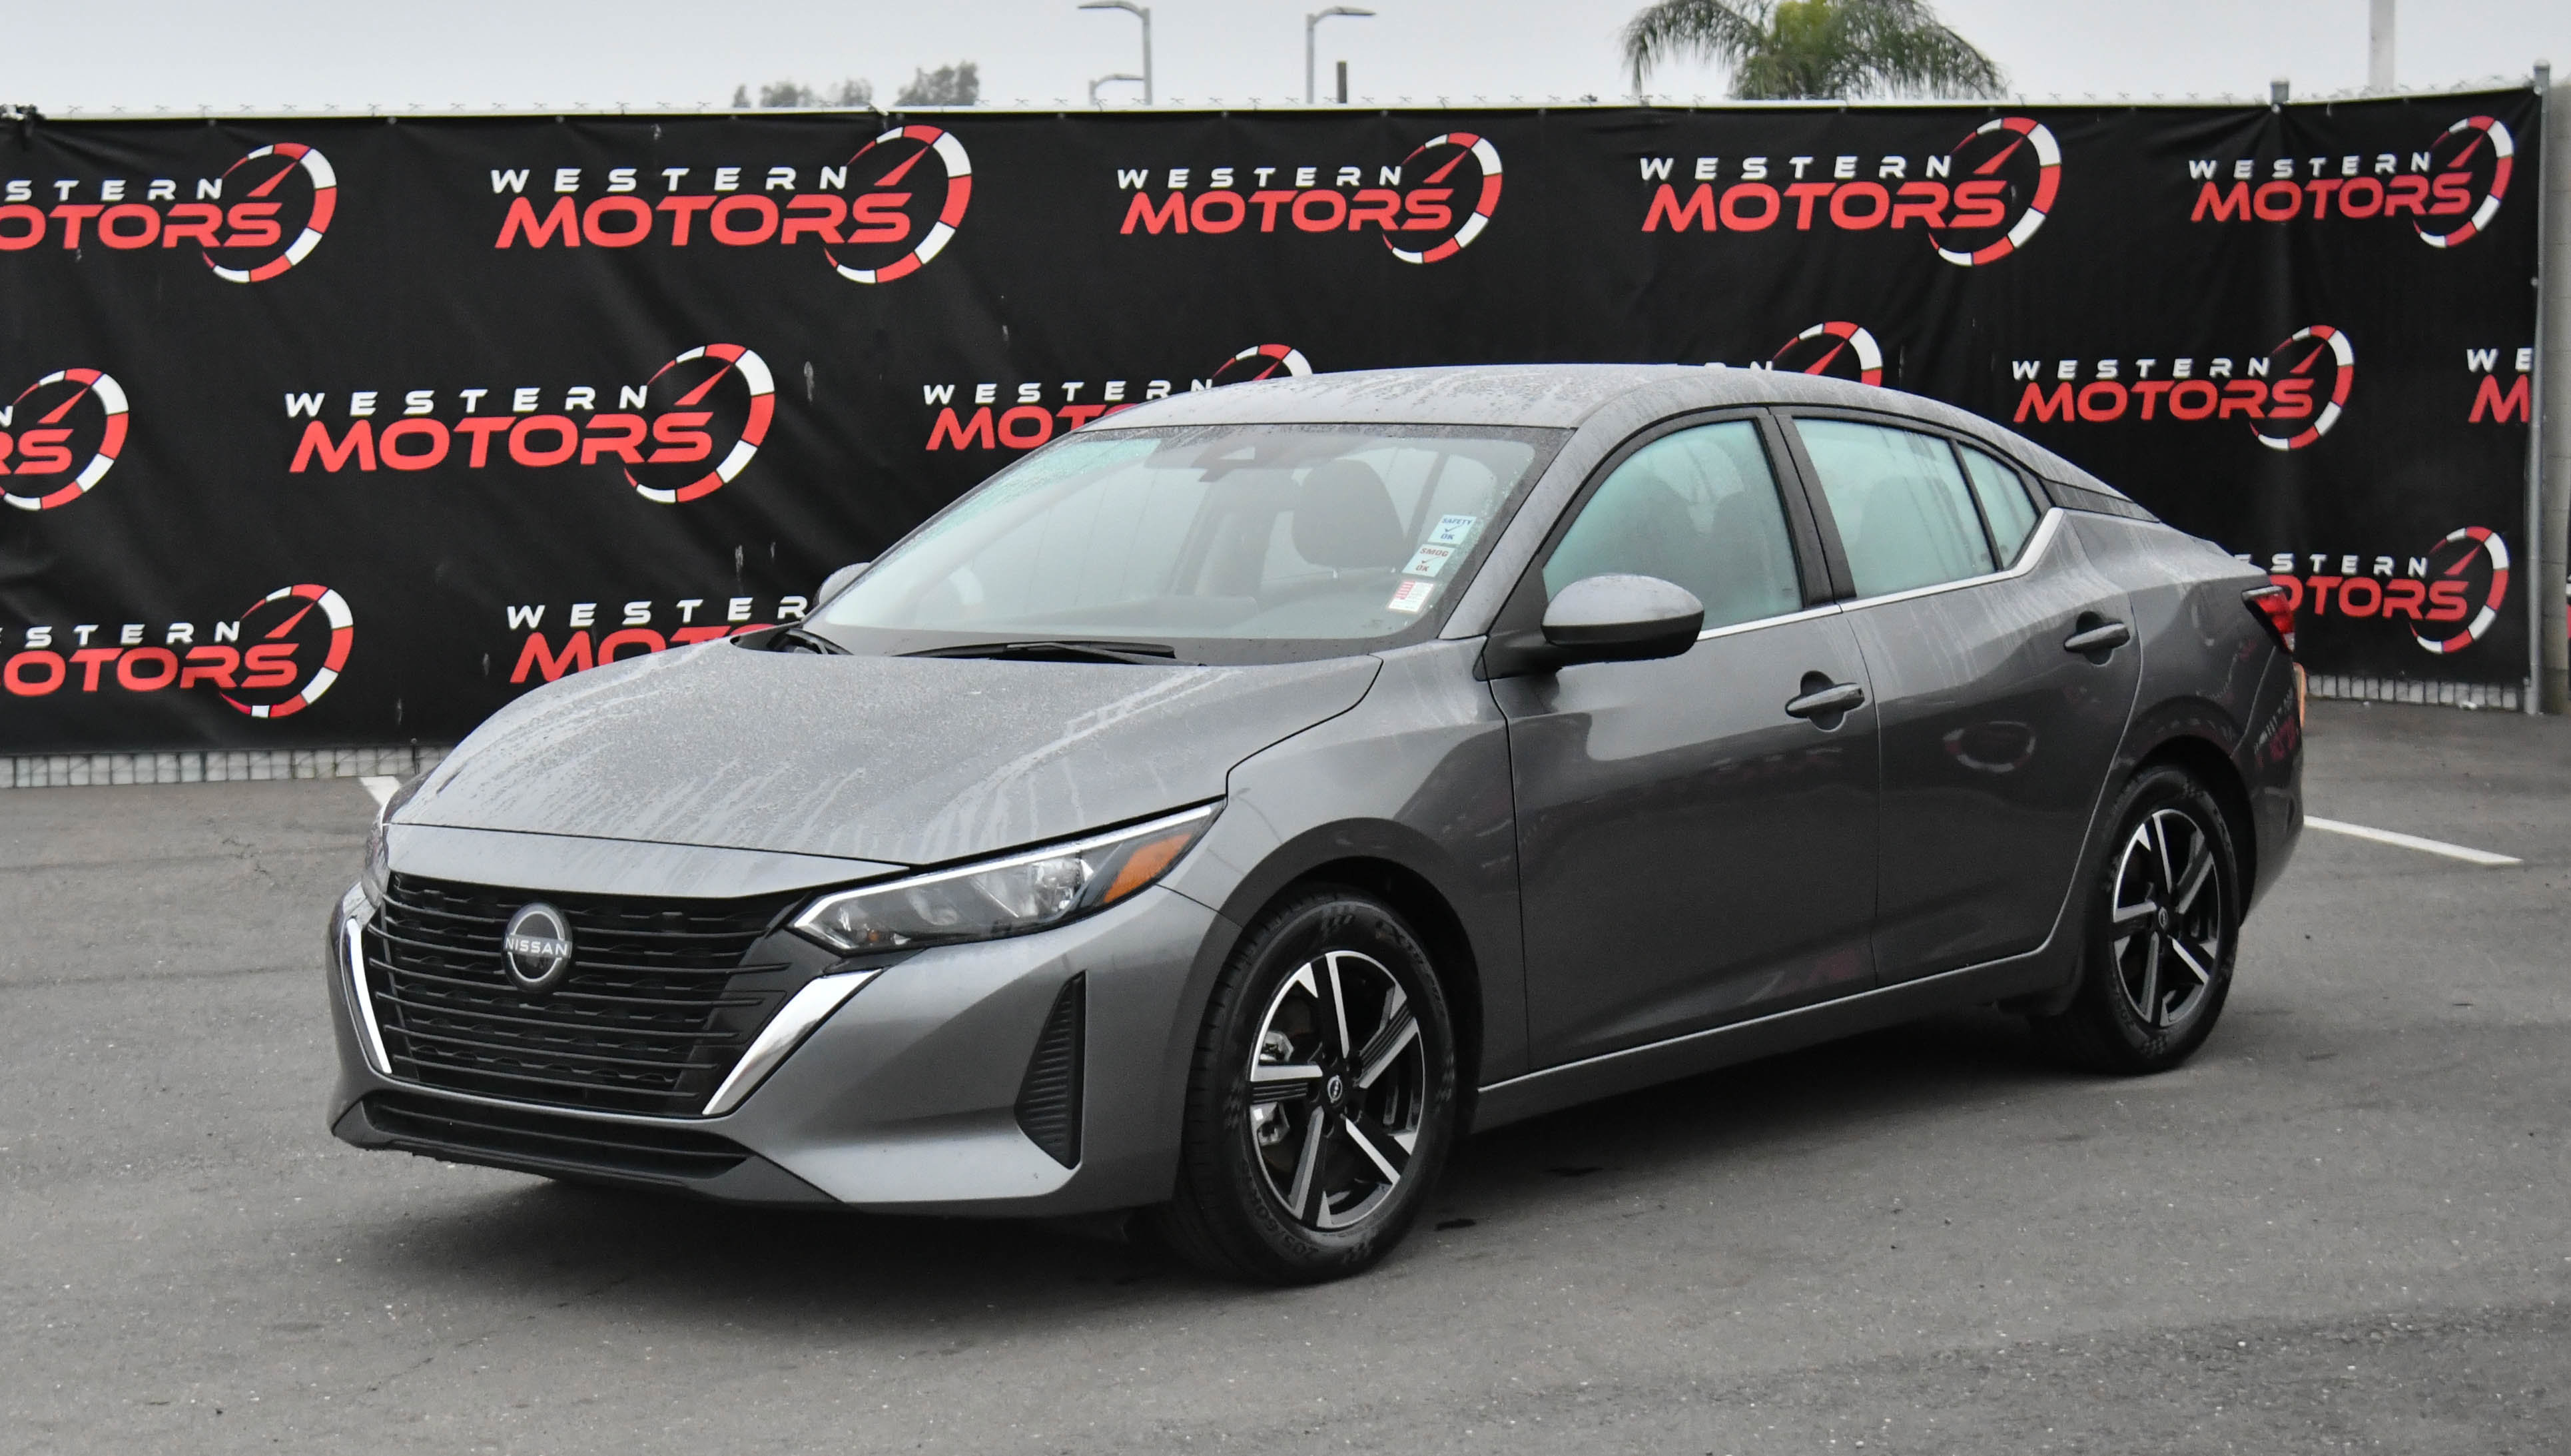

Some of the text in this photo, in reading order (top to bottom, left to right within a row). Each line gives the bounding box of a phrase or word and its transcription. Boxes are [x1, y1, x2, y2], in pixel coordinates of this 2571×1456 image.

[1117, 166, 1402, 189] WESTERN
[1640, 155, 1952, 181] WESTERN
[2189, 152, 2430, 179] WESTERN
[491, 166, 848, 194] WESTERN
[1642, 180, 2007, 232] MOTORS
[2191, 172, 2471, 222] MOTORS
[495, 192, 912, 249] MOTORS
[1120, 188, 1453, 235] MOTORS
[2012, 357, 2270, 380] WESTERN
[285, 385, 648, 418] WESTERN
[923, 378, 1212, 405] WESTERN
[2014, 378, 2314, 423] MOTORS
[926, 403, 1137, 450] MOT
[290, 412, 714, 473] MOTORS
[1419, 547, 1449, 557] SMOG
[0, 621, 240, 648] STERN
[505, 937, 568, 956] NISSAN
